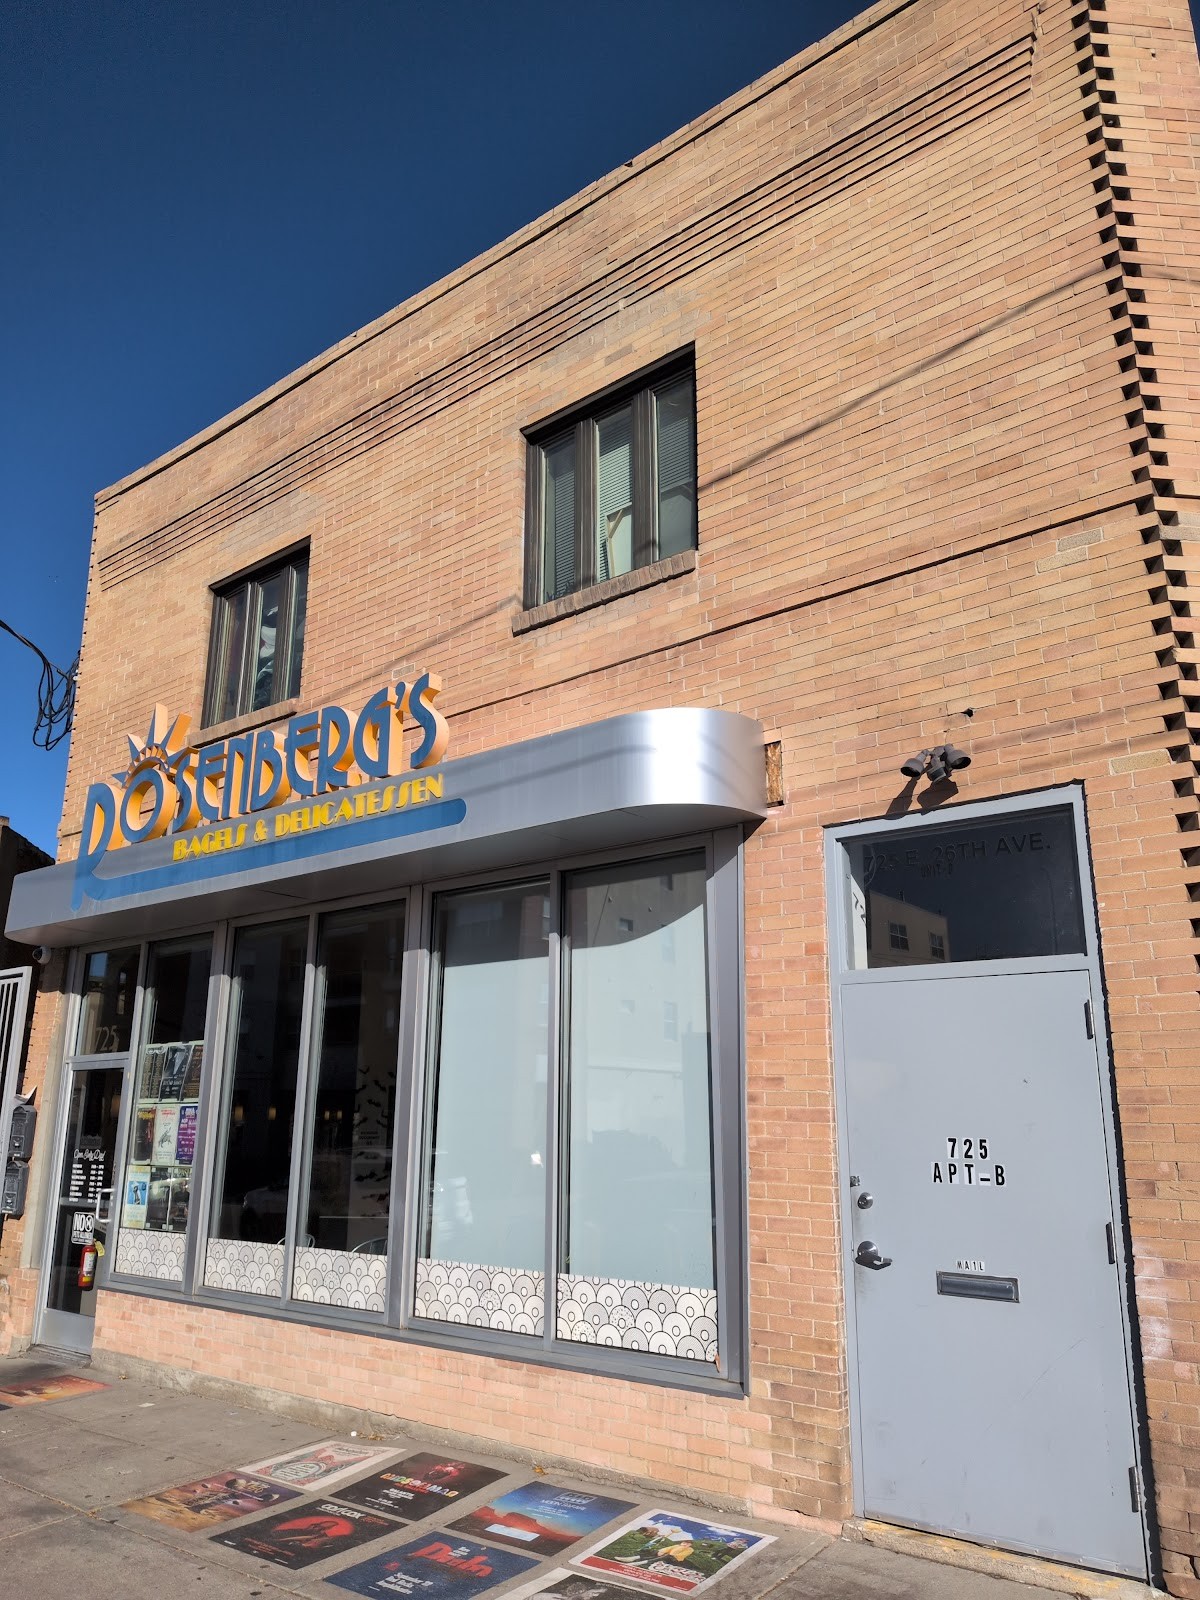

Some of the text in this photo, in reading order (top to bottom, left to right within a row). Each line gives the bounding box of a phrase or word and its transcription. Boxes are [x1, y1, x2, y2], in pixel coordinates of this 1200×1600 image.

[72, 672, 450, 912] ROSENBERG'S
[173, 773, 445, 862] BAGELS & DELICATESSEN
[932, 839, 988, 864] 26TH
[996, 832, 1051, 856] AVE.
[95, 1025, 120, 1051] 725
[947, 1138, 988, 1159] 725
[73, 1213, 85, 1231] NO
